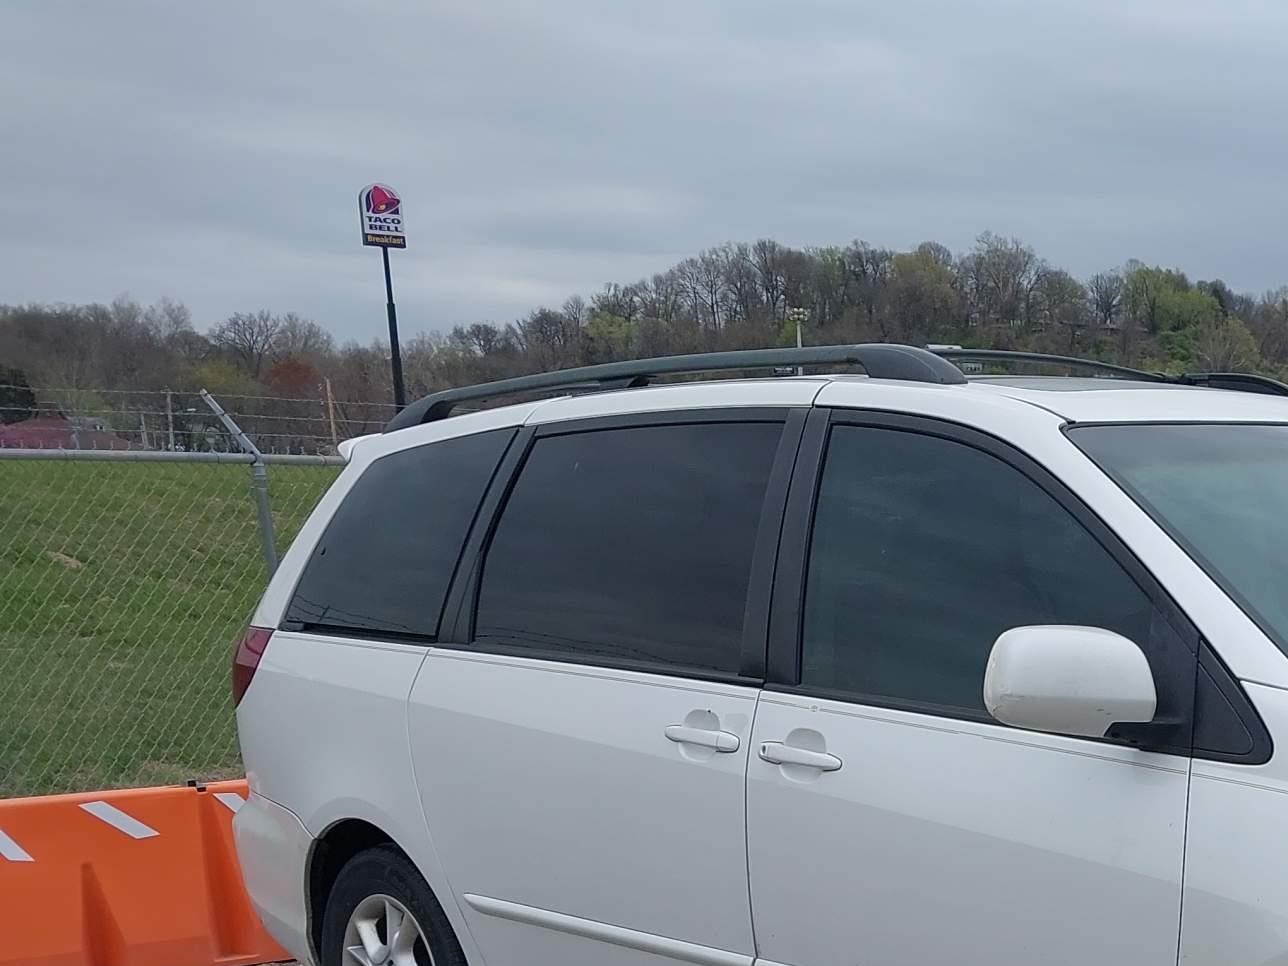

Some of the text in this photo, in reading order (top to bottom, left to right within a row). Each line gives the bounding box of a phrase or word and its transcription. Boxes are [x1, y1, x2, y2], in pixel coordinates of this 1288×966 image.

[366, 216, 401, 224] TACO
[369, 224, 403, 232] BELL
[368, 235, 404, 244] Breakfast
